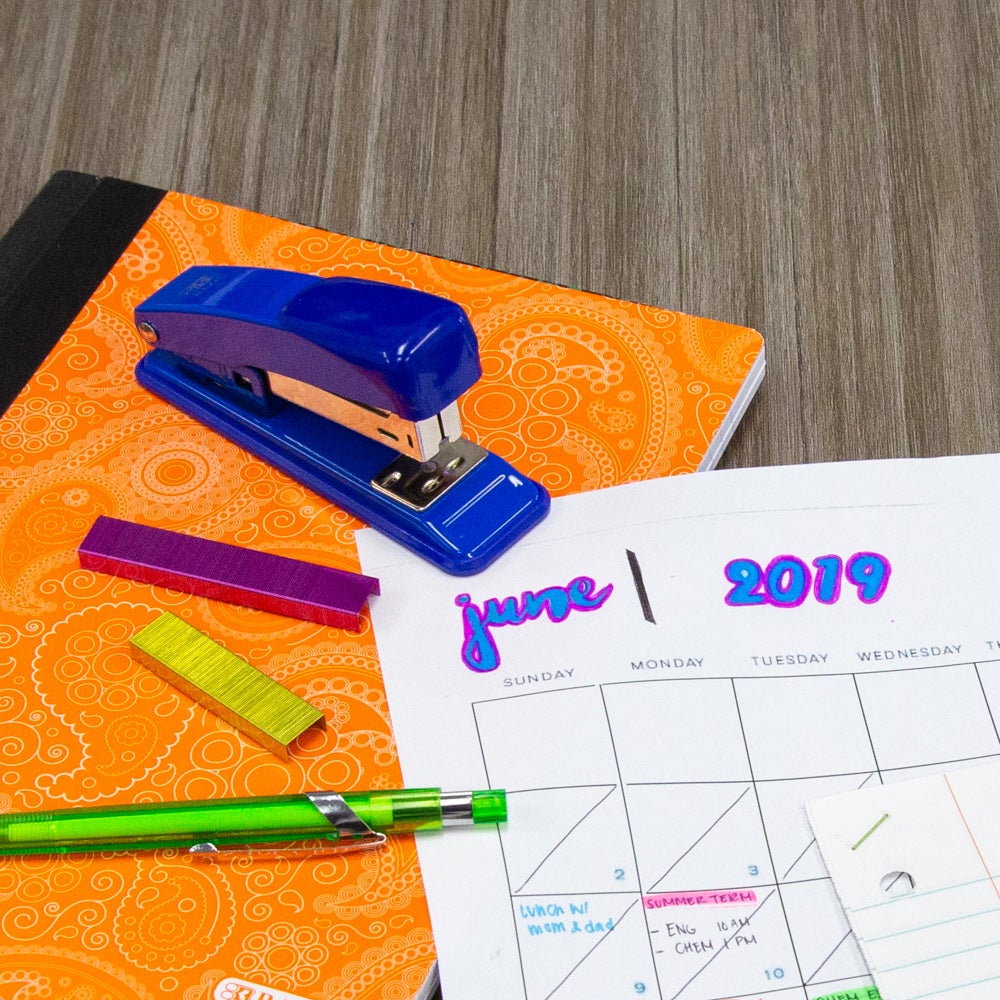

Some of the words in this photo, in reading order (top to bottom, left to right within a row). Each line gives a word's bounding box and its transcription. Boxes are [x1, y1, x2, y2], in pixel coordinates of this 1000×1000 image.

[455, 577, 613, 672] june
[724, 552, 891, 608] 2019
[503, 669, 575, 688] SUNDAY
[631, 657, 705, 671] MONDAY
[751, 654, 828, 667] TUESDAY
[857, 645, 963, 662] WEDNESDAY
[614, 869, 626, 880] 2
[748, 866, 759, 876] 3
[647, 897, 705, 909] SUMMER
[709, 892, 752, 904] TERM
[667, 922, 696, 937] ENG
[675, 939, 712, 954] CHEM
[764, 968, 784, 980] 10
[634, 982, 646, 993] 9
